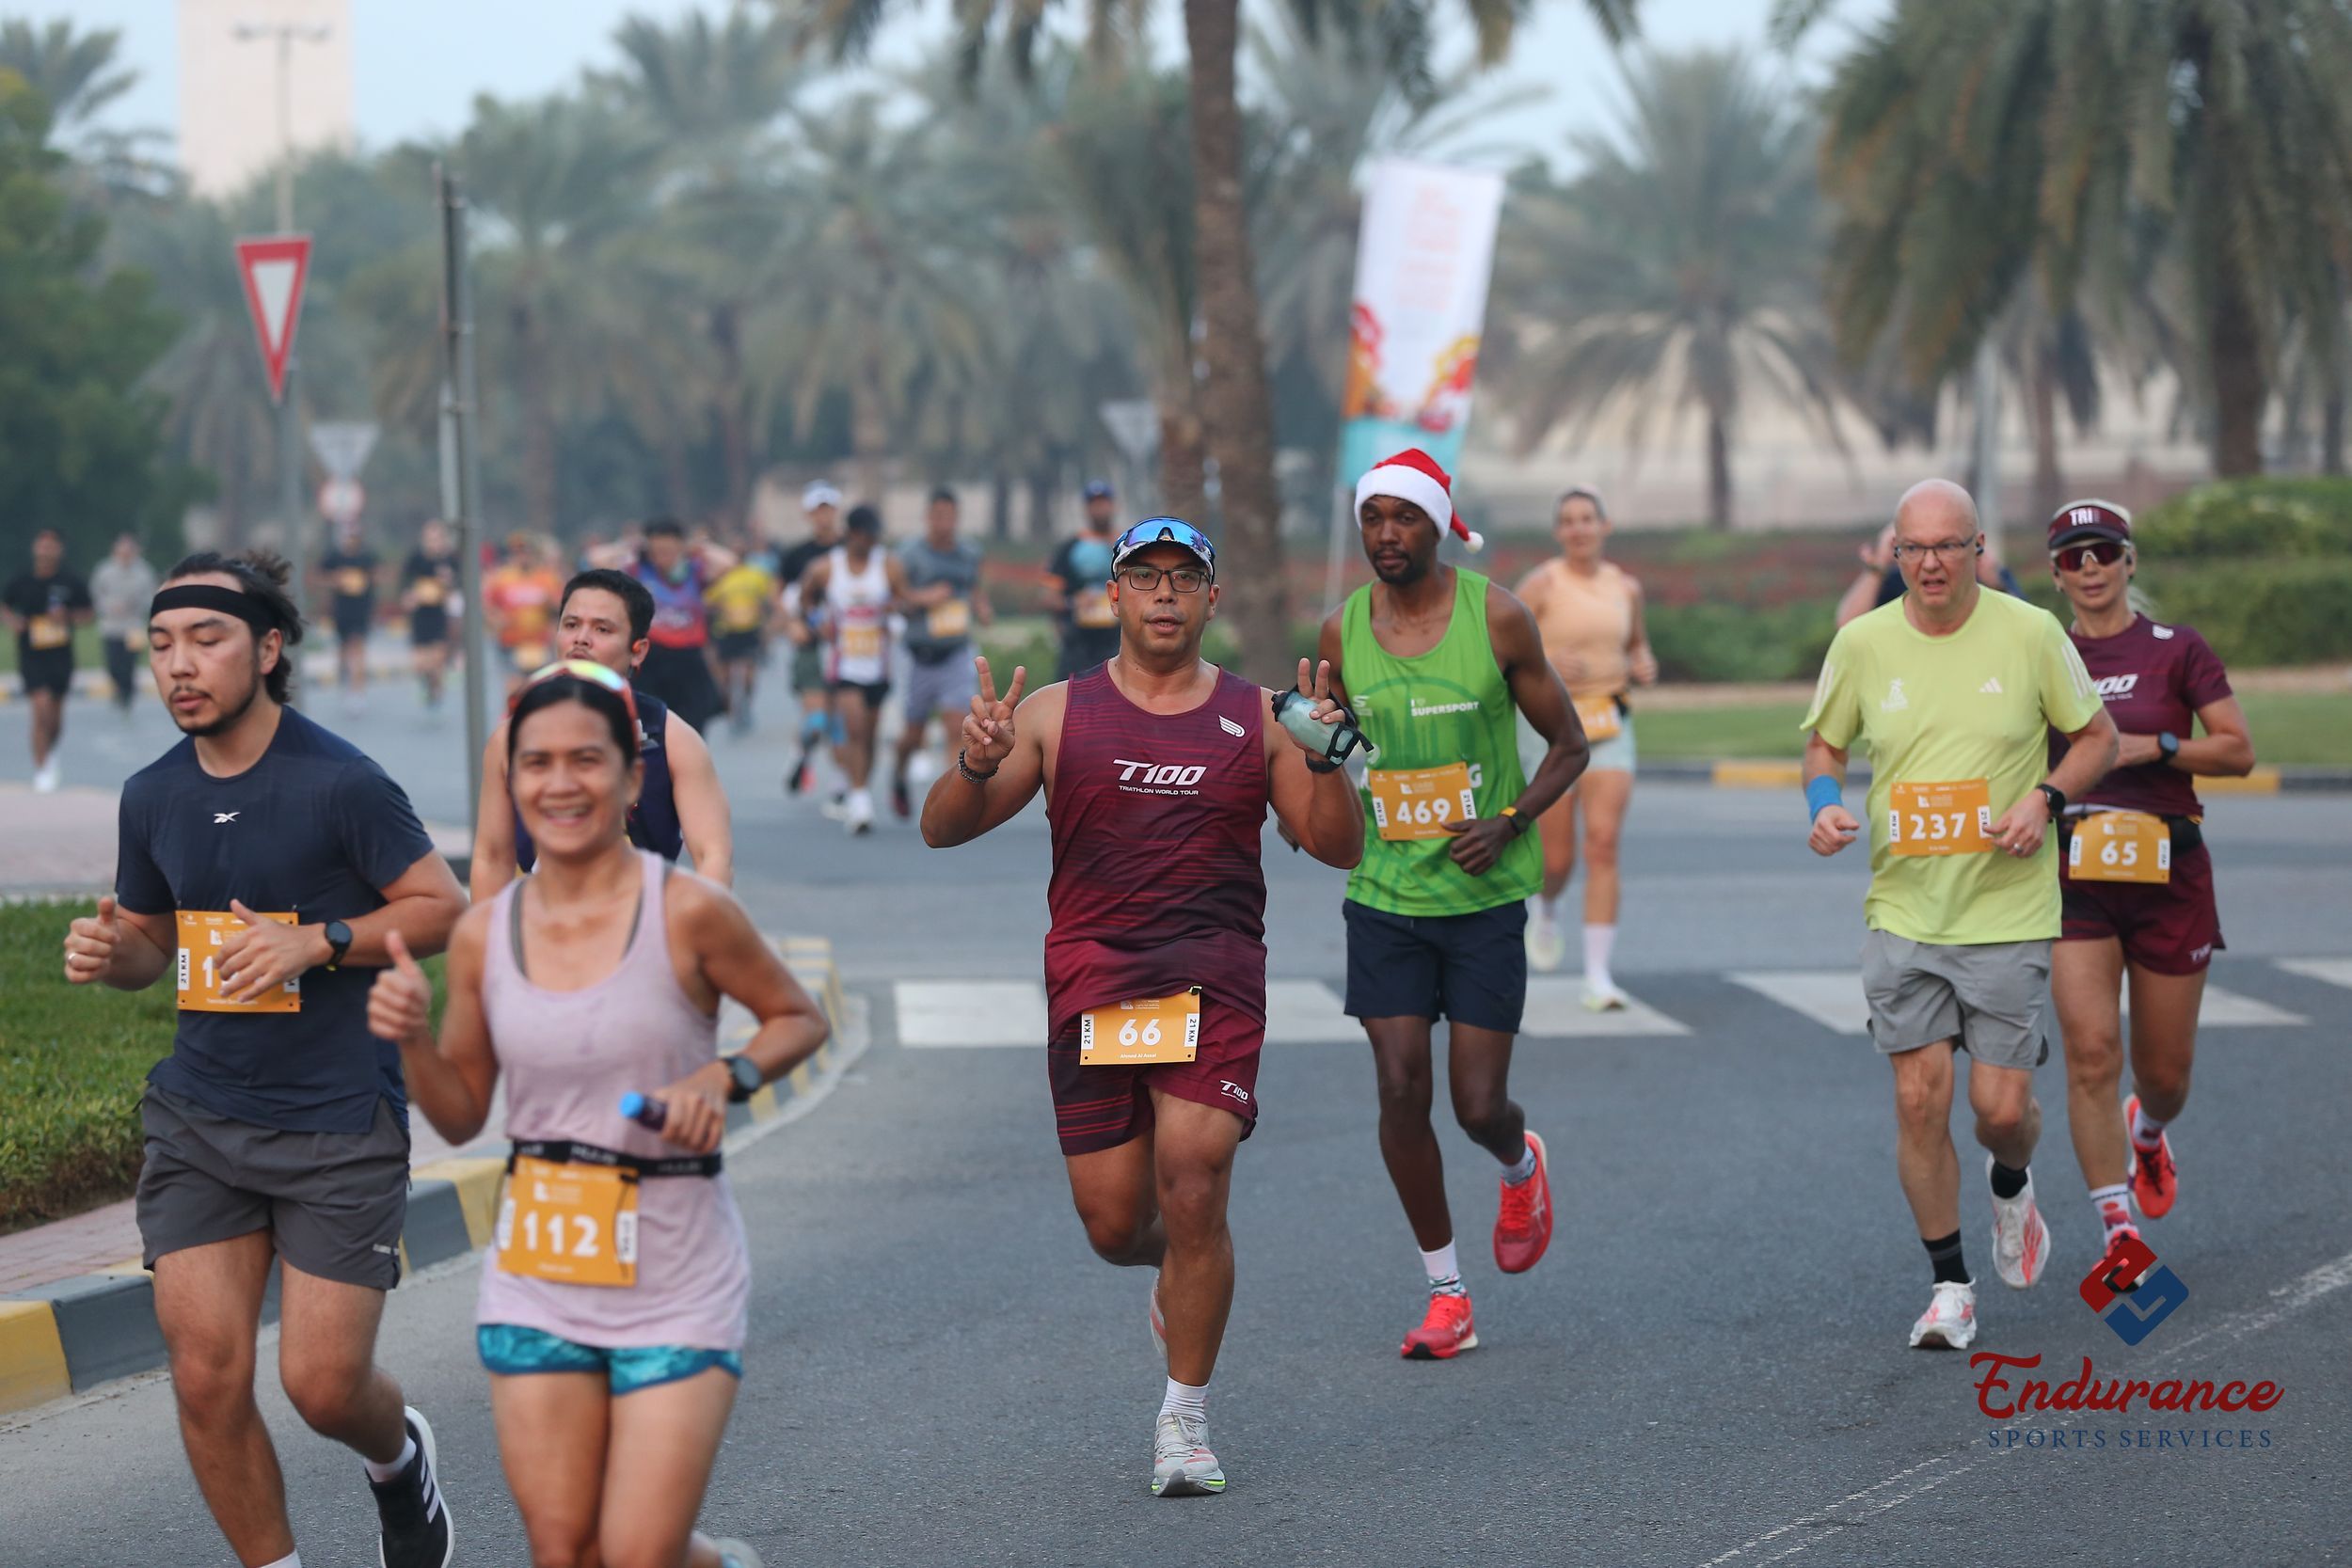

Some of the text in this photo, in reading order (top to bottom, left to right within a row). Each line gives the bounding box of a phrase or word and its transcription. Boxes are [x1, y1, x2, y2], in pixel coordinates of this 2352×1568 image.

[1411, 702, 1479, 717] SUPERSPORT
[1113, 759, 1207, 785] T100
[1119, 785, 1154, 794] TRIATHLON
[1396, 798, 1452, 825] 469
[1910, 813, 1966, 840] 237
[2100, 840, 2138, 865] 65
[1084, 1019, 1091, 1033] KM
[1119, 1019, 1162, 1046] 66
[1187, 1030, 1196, 1042] KM
[1219, 1080, 1248, 1101] T100
[523, 1211, 600, 1258] 112
